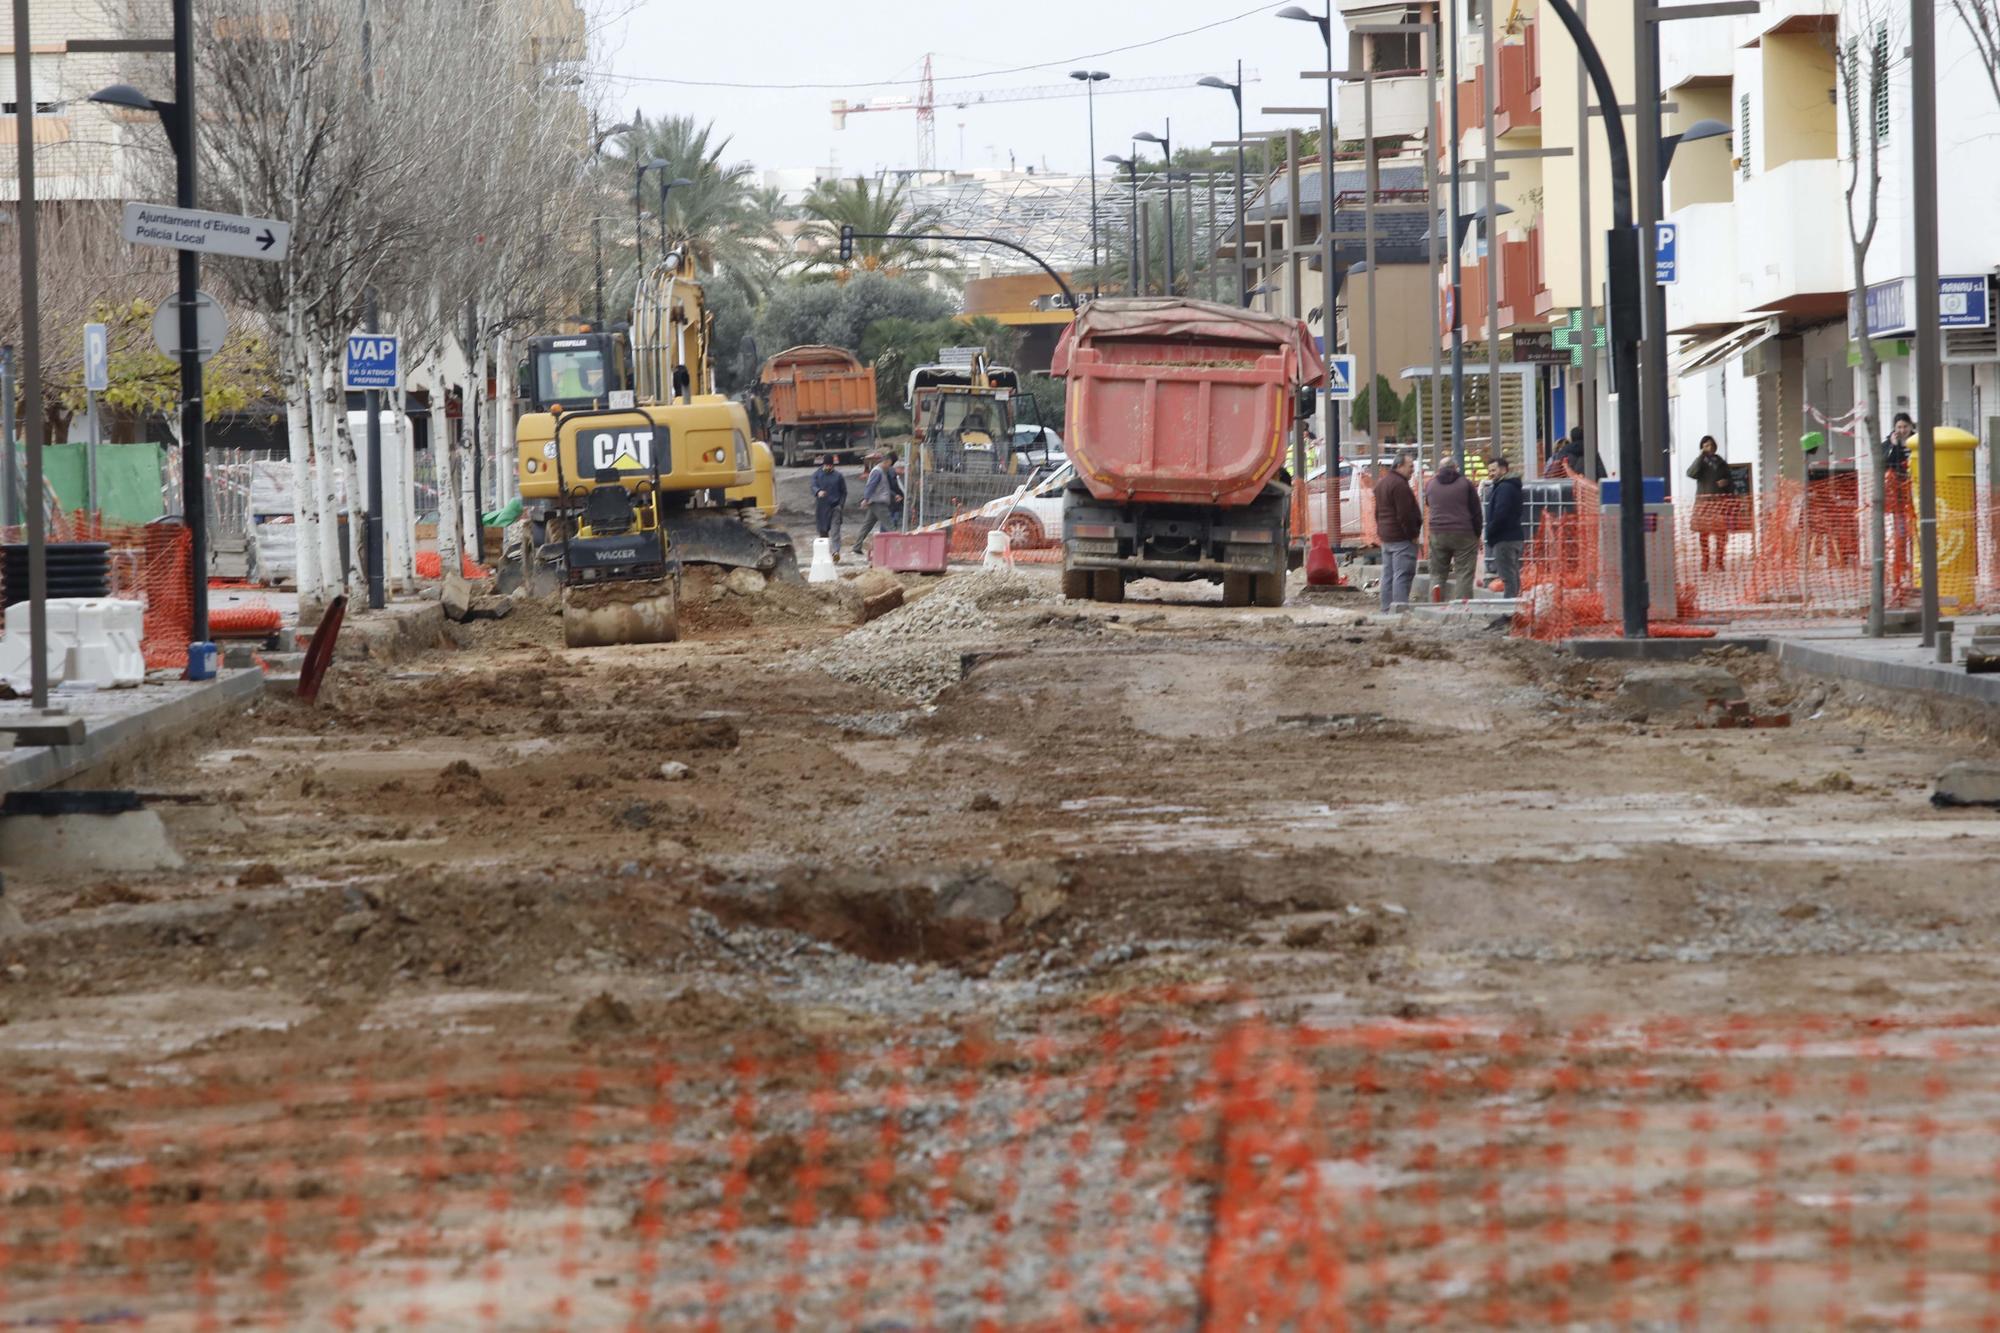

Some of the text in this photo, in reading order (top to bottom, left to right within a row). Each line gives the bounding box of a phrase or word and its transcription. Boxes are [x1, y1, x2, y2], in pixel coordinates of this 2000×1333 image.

[138, 210, 250, 235] Ajuntament d'Eivissa
[175, 231, 205, 245] Local
[91, 333, 103, 382] P
[349, 340, 394, 361] VAP
[592, 431, 654, 470] CAT
